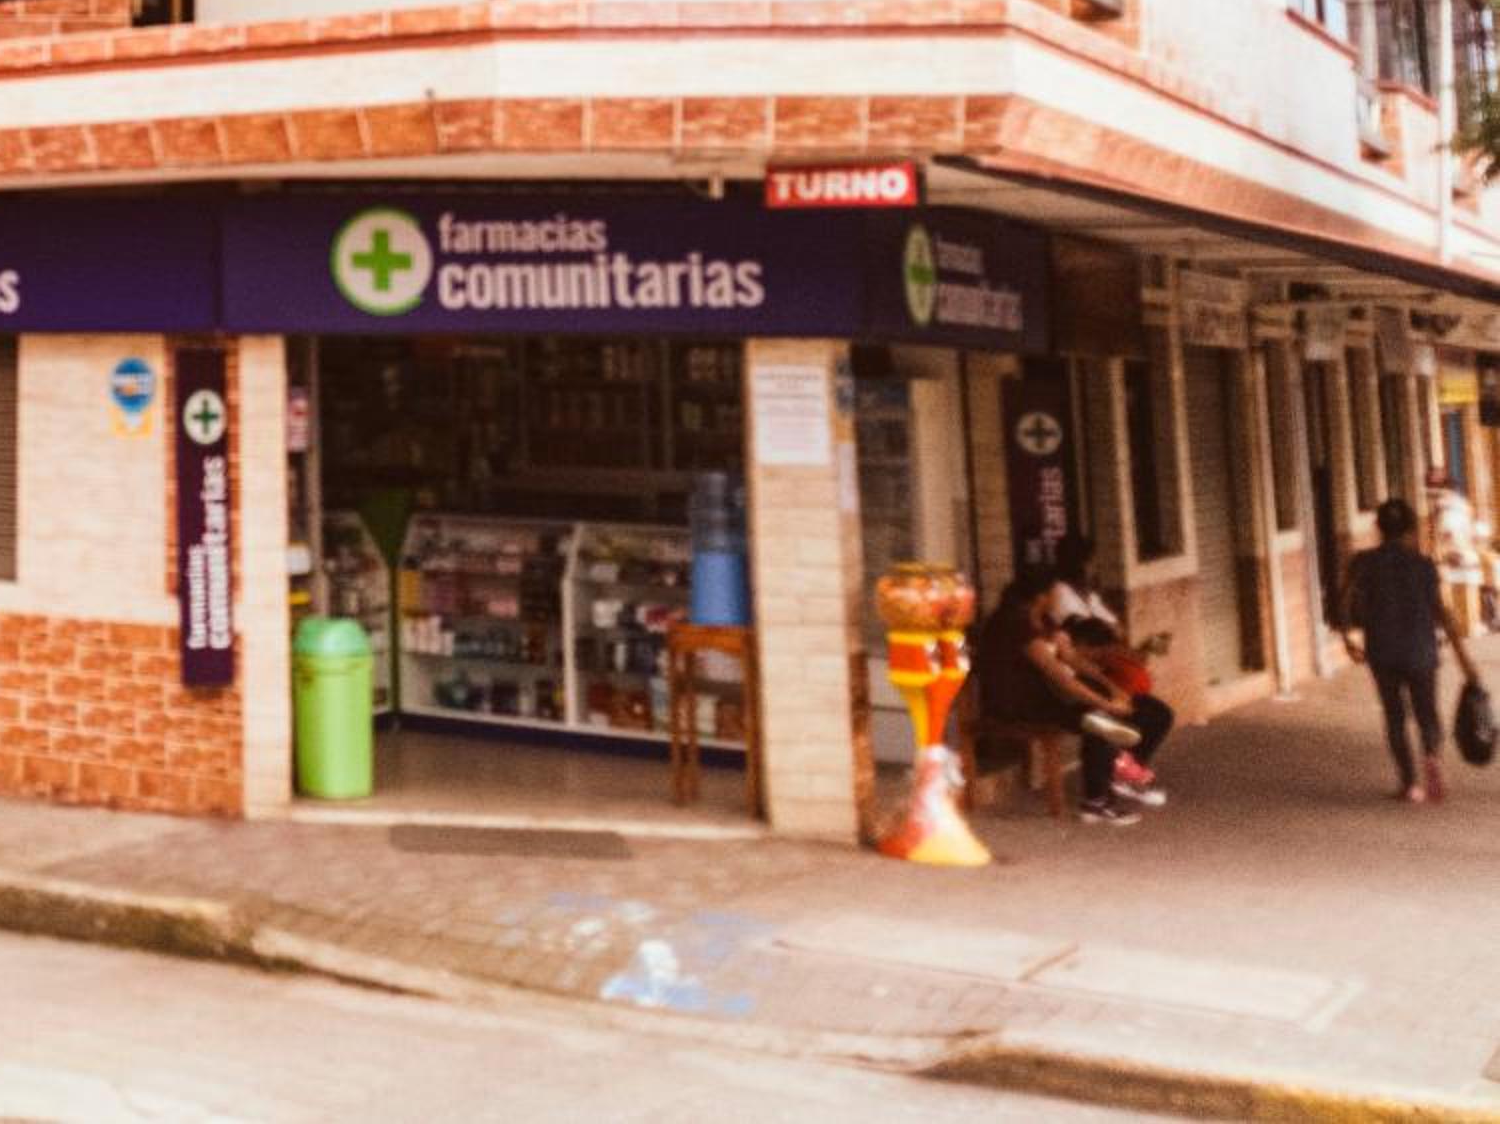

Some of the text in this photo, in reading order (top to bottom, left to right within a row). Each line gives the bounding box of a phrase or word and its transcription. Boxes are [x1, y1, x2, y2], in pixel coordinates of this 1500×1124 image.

[772, 169, 909, 202] TURNO
[438, 213, 608, 254] farmacias
[437, 251, 766, 309] comunitarias
